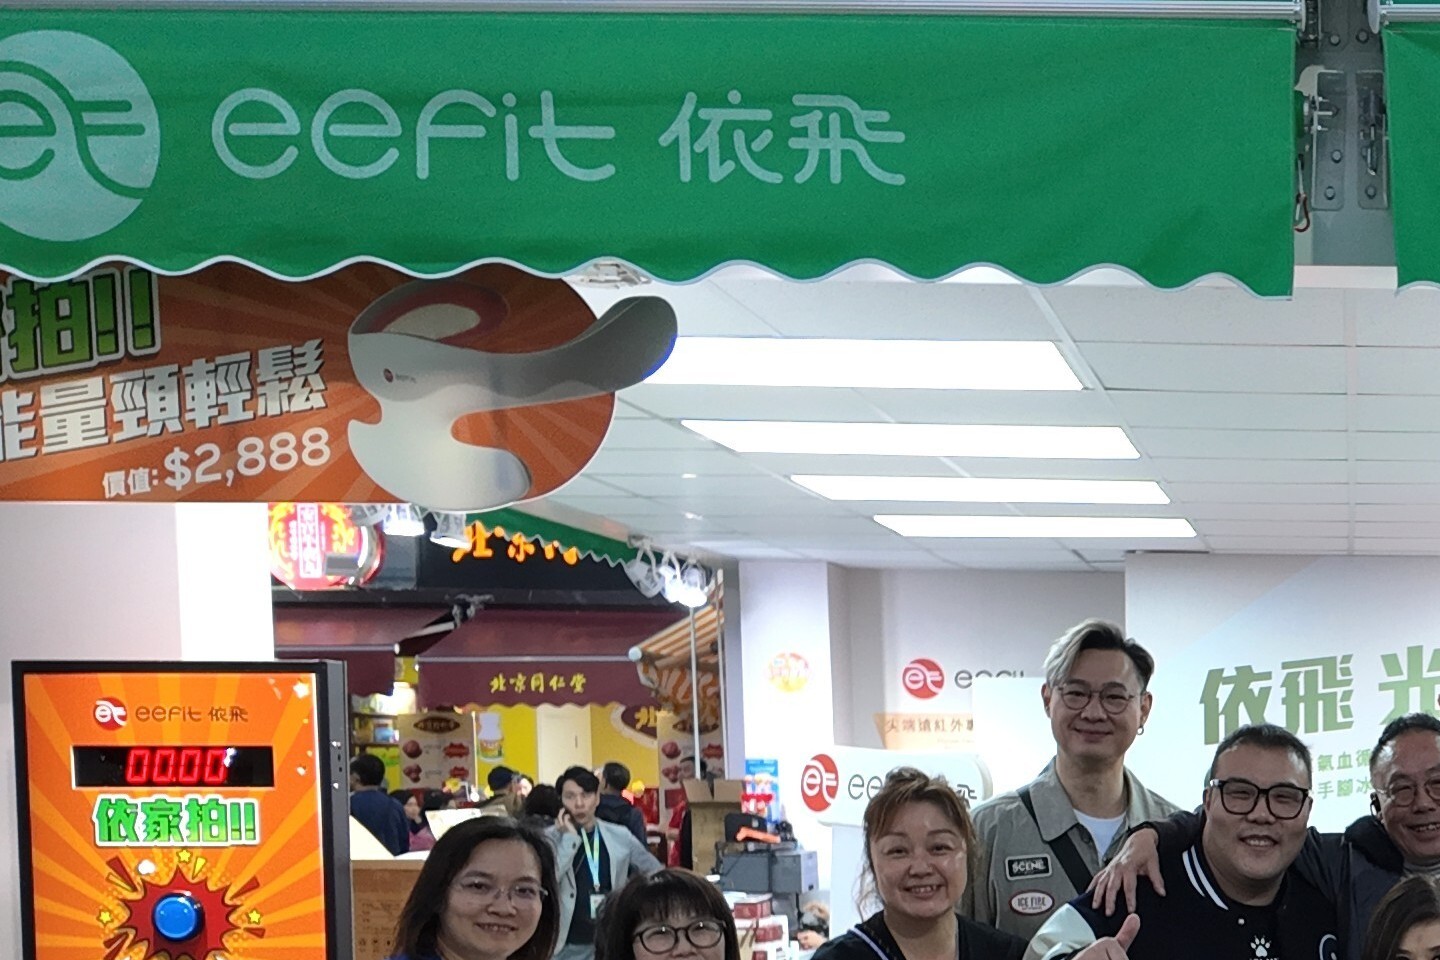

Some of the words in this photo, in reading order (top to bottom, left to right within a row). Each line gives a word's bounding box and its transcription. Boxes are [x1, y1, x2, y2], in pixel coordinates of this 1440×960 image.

[211, 87, 616, 182] eefit
[658, 89, 906, 186] 依飛
[0, 267, 158, 374] 拍!!
[163, 427, 332, 491] $2,888
[135, 706, 202, 723] eefit
[207, 706, 249, 723] 依飛
[489, 672, 587, 693] 北京同仁堂
[1199, 654, 1354, 746] 依飛
